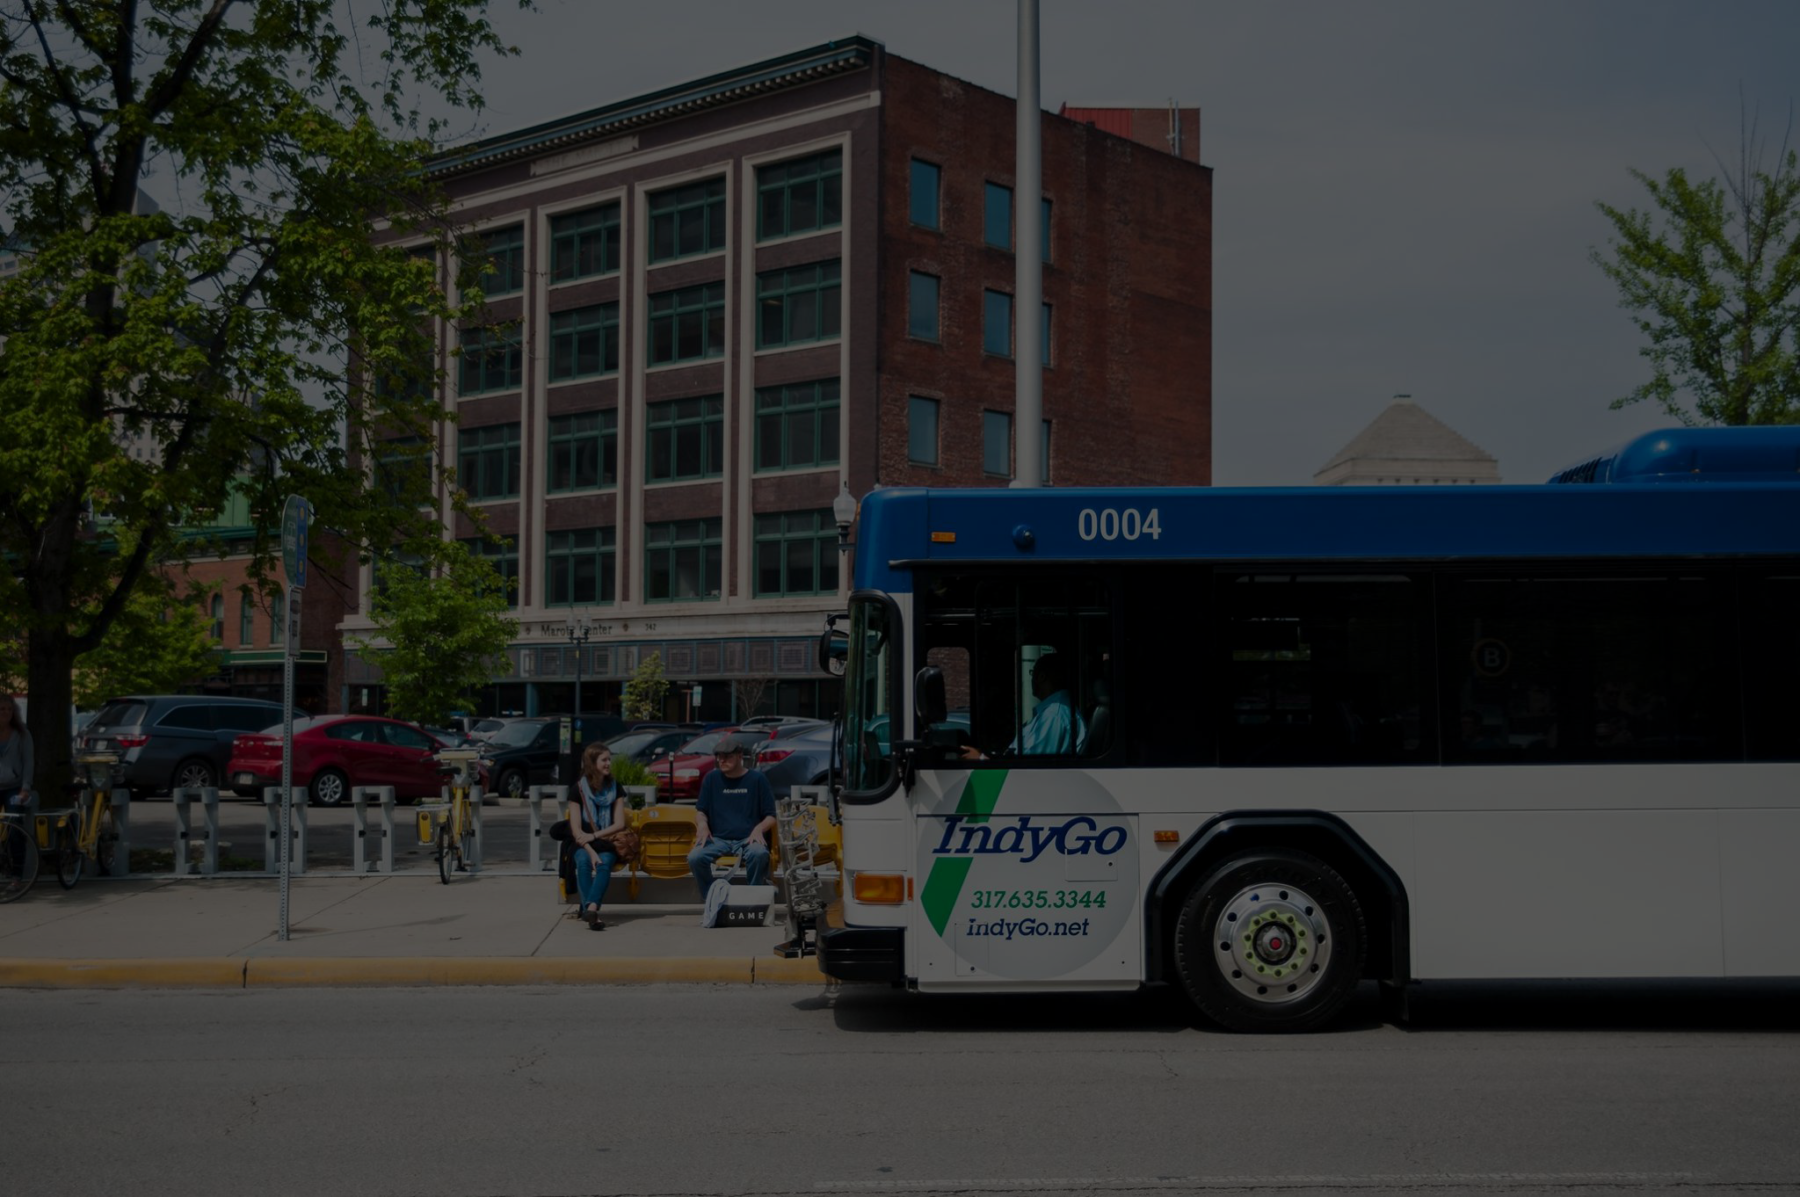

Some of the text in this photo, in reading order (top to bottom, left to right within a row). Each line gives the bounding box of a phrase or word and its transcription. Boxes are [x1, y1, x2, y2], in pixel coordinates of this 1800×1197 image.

[1078, 508, 1162, 541] 0004
[1483, 647, 1501, 668] B
[932, 816, 1127, 863] IndyGo
[971, 890, 1106, 909] 317.635.3344
[728, 911, 764, 920] GAME
[967, 917, 1089, 941] IndyGo.net
